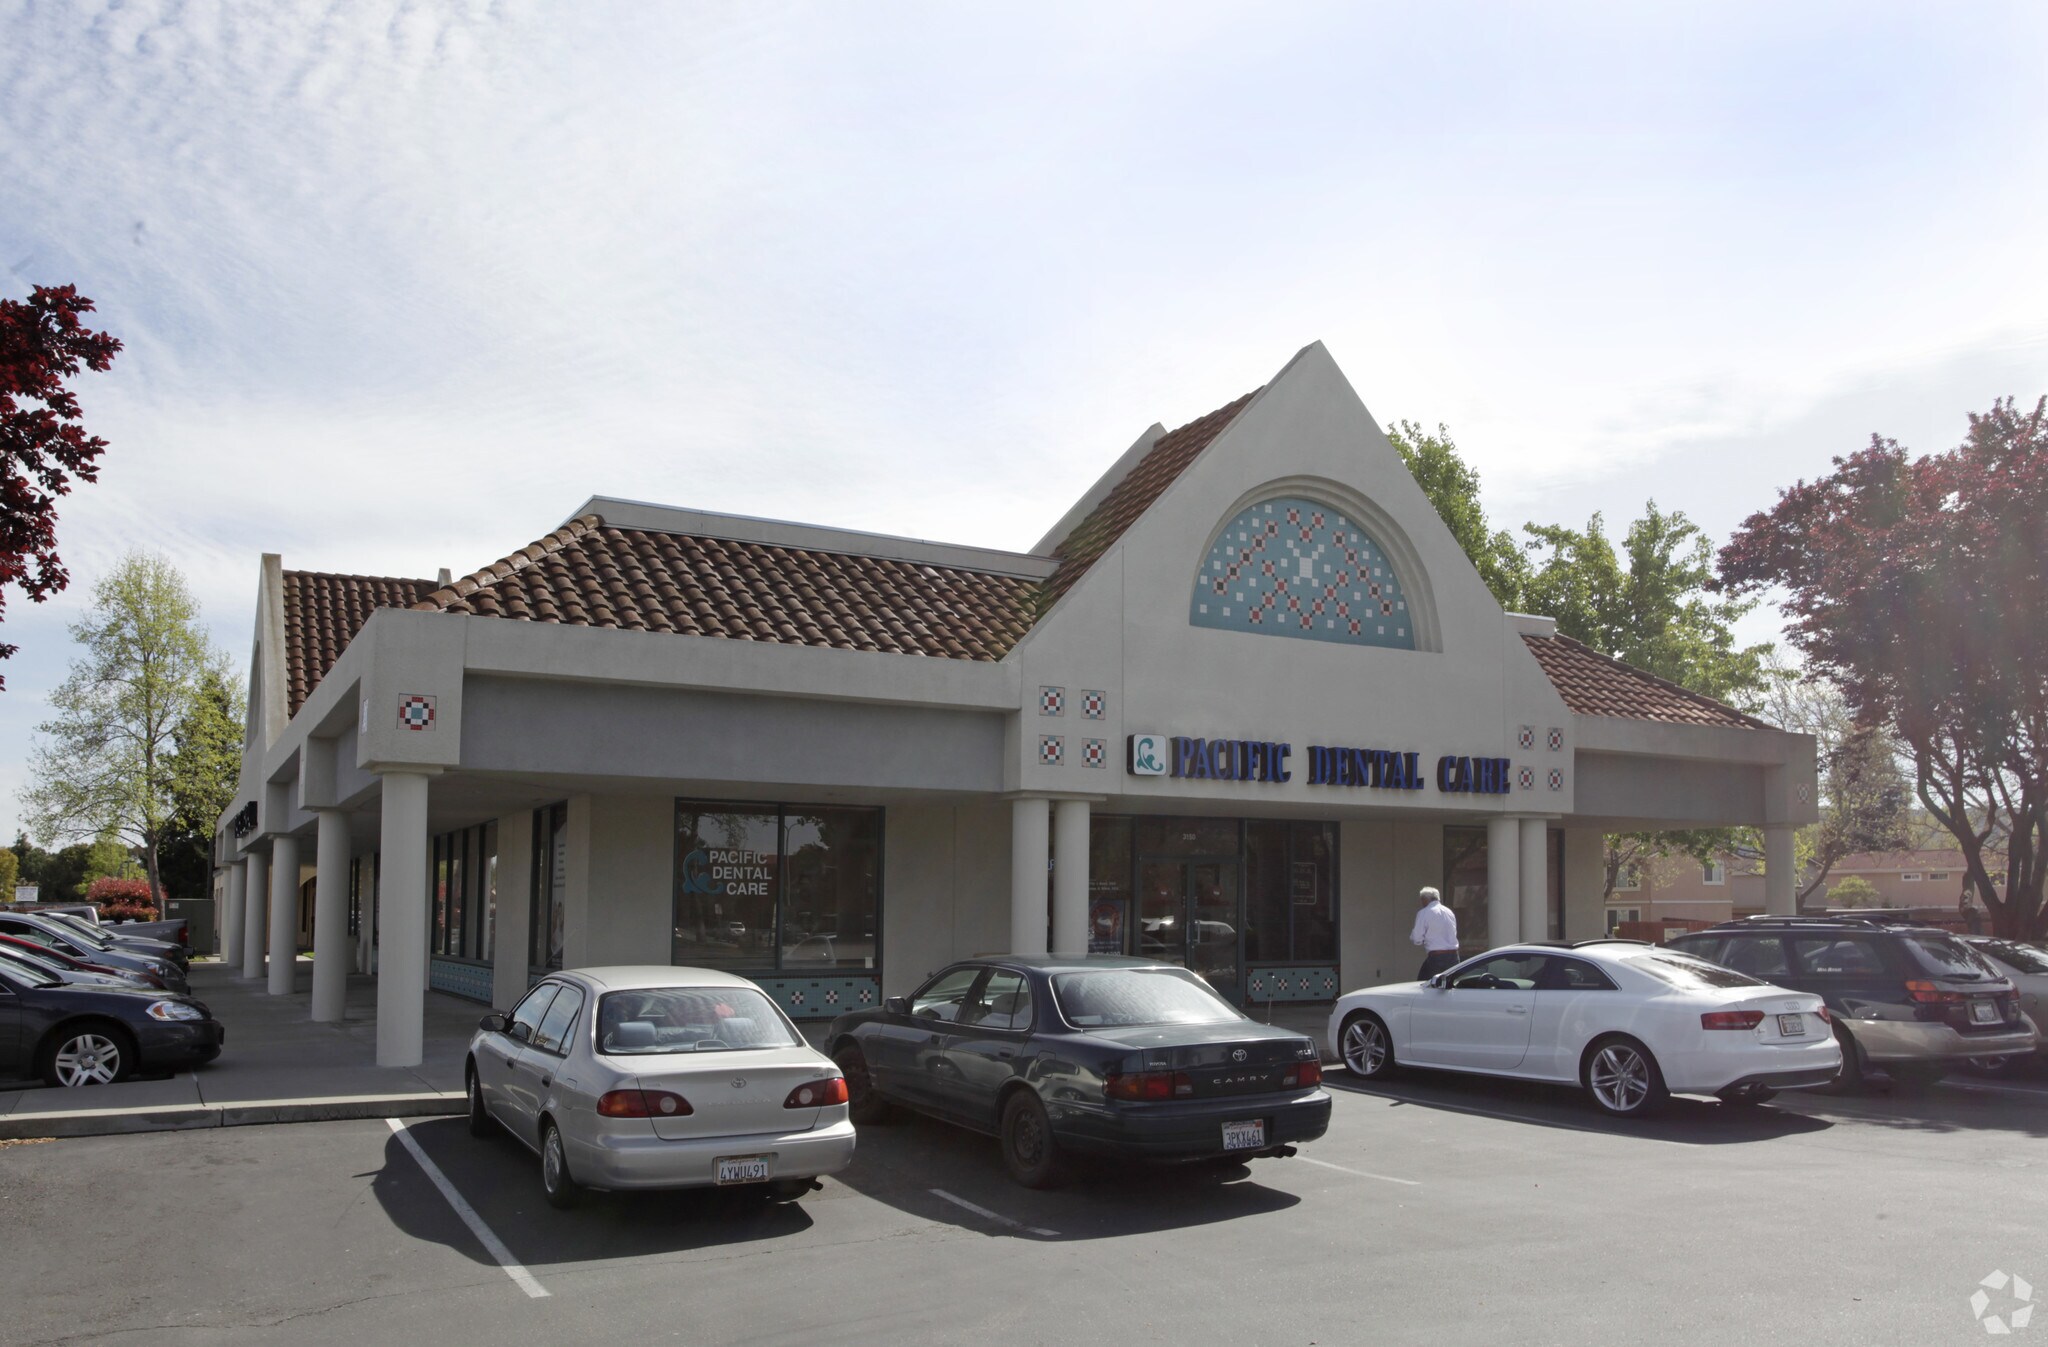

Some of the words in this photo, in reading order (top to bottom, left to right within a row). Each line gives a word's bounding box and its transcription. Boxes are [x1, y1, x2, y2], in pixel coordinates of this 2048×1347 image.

[1169, 736, 1291, 783] PACIFIC
[1307, 746, 1425, 790] DENTAL
[1437, 755, 1511, 794] CARE
[1182, 833, 1197, 841] 3150
[709, 850, 768, 864] PACIFIC
[712, 866, 772, 880] DENTAL
[726, 882, 768, 896] CARE
[1212, 1074, 1269, 1085] CAMRY
[1226, 1129, 1261, 1145] 3PKX461
[720, 1164, 765, 1180] 4YWU491
